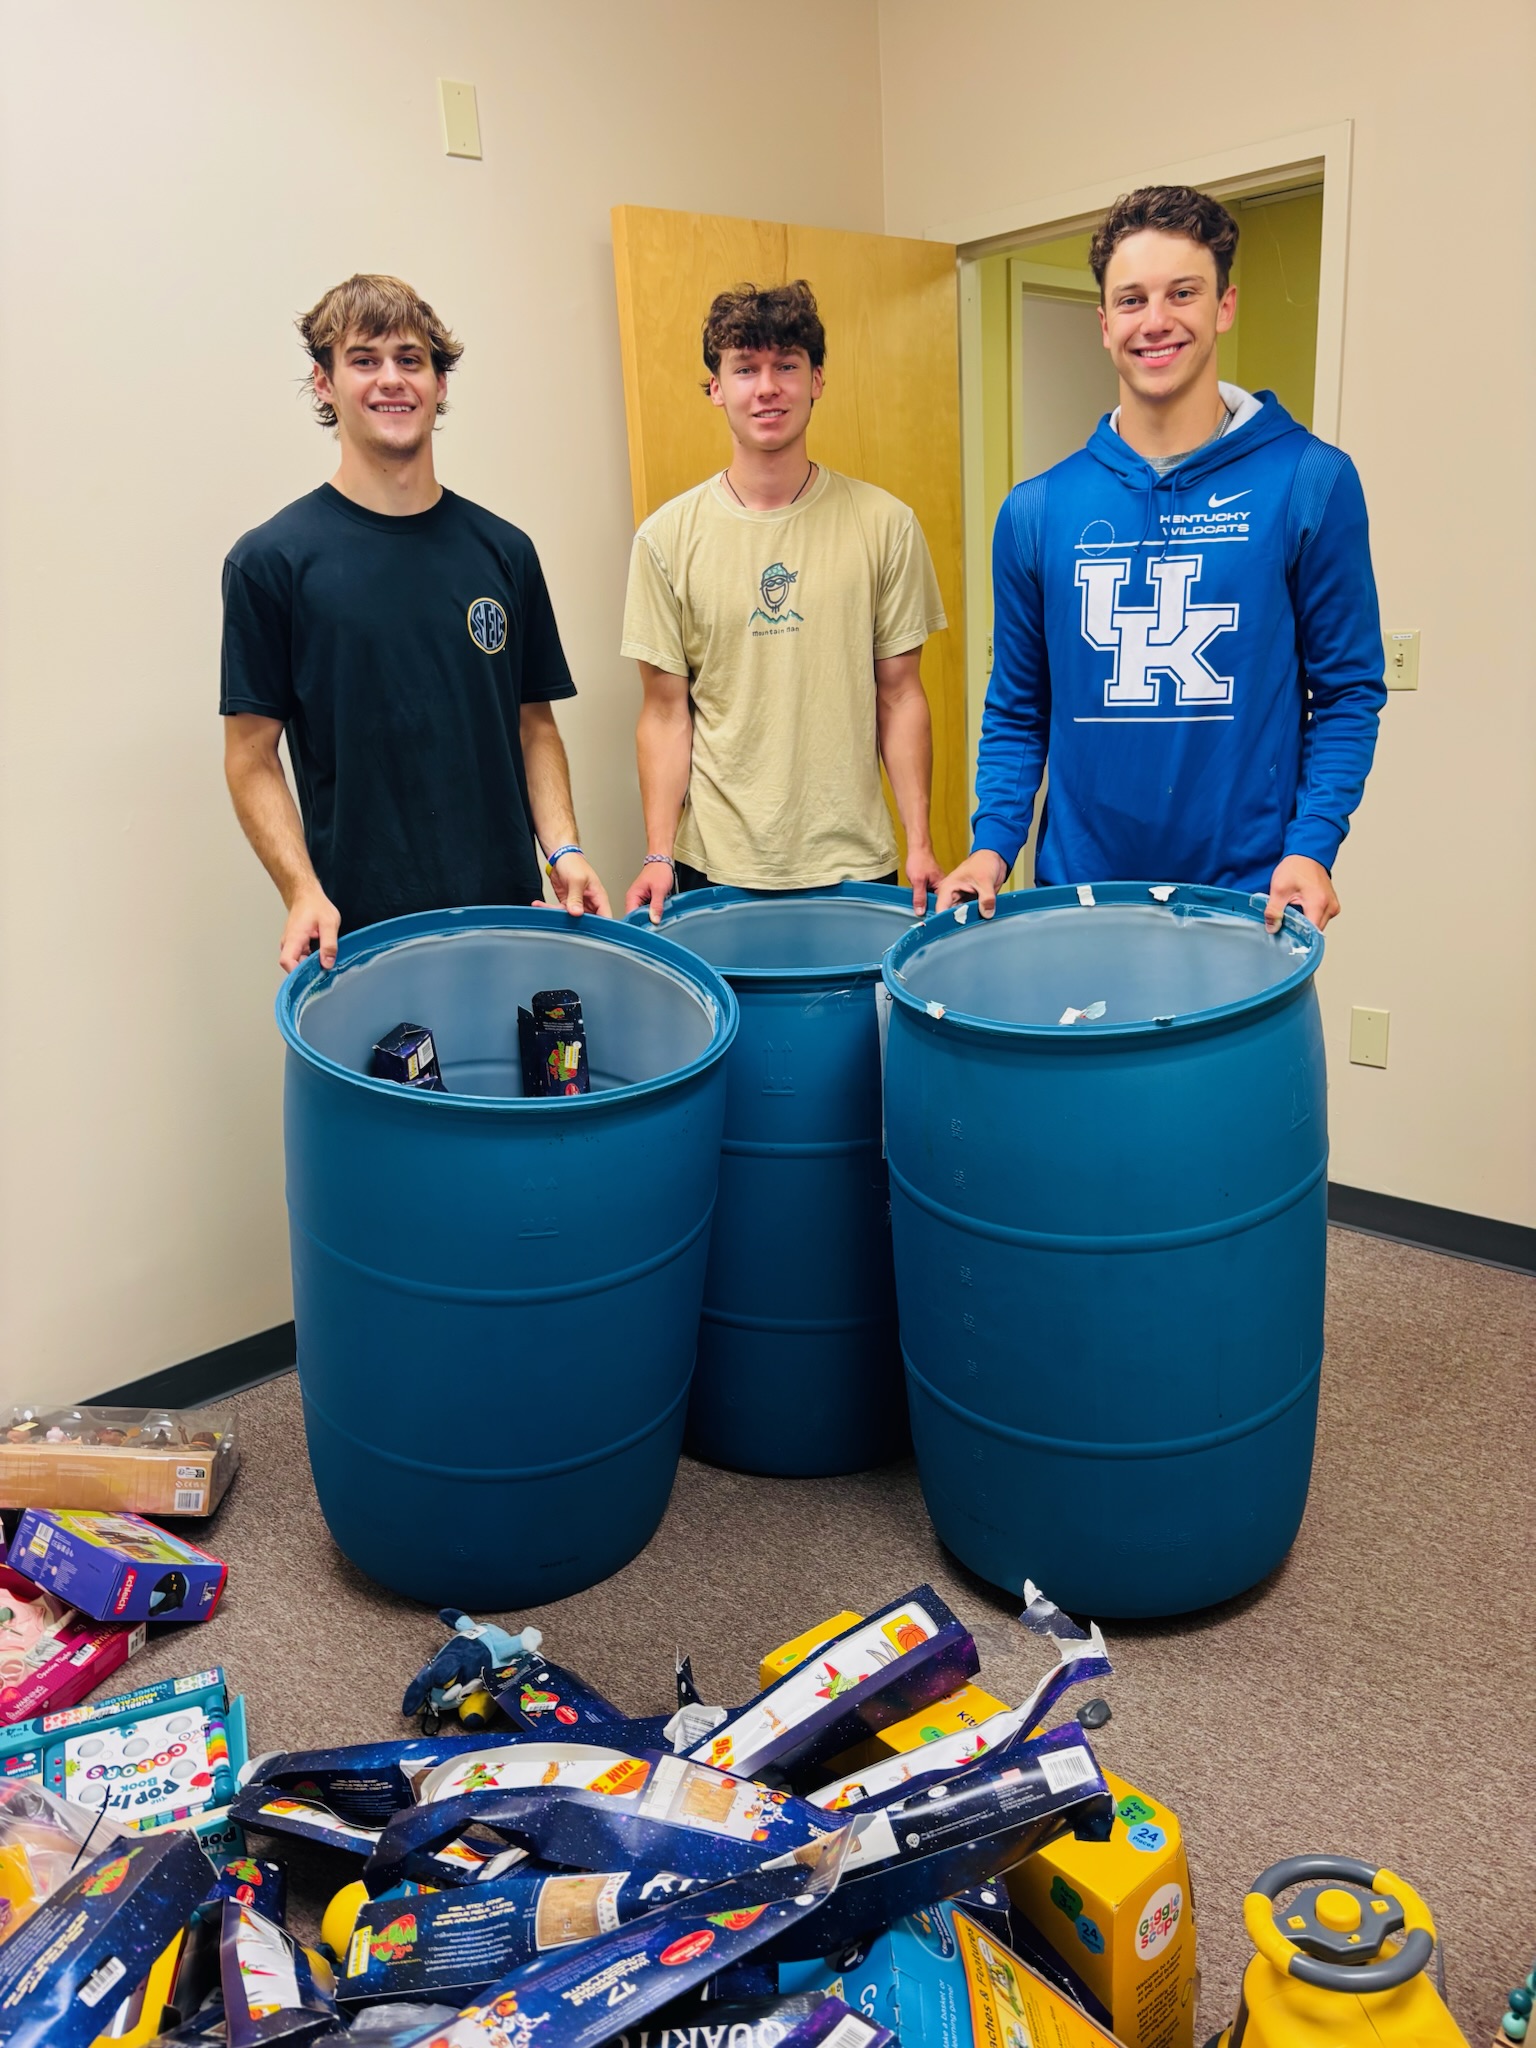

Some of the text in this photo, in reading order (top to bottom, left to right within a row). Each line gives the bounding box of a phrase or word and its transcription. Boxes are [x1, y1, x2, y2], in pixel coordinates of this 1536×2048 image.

[1160, 511, 1251, 524] KENTUCKY
[1162, 523, 1250, 536] WILDCATS
[1073, 553, 1240, 707] UK
[116, 1574, 135, 1611] schleich
[112, 1692, 158, 1707] MAGICALL
[133, 1683, 168, 1697] CHANGE
[956, 1711, 979, 1727] Kit
[88, 1744, 186, 1779] COLORS
[606, 1760, 635, 1785] JAM
[134, 1779, 181, 1805] POP
[1120, 1807, 1137, 1821] 3+
[1130, 1801, 1147, 1816] Ages
[1137, 1828, 1159, 1843] 24
[1081, 1922, 1099, 1942] 24
[965, 1925, 987, 1987] Features
[606, 1981, 638, 2007] 17
[939, 1991, 948, 2020] basket
